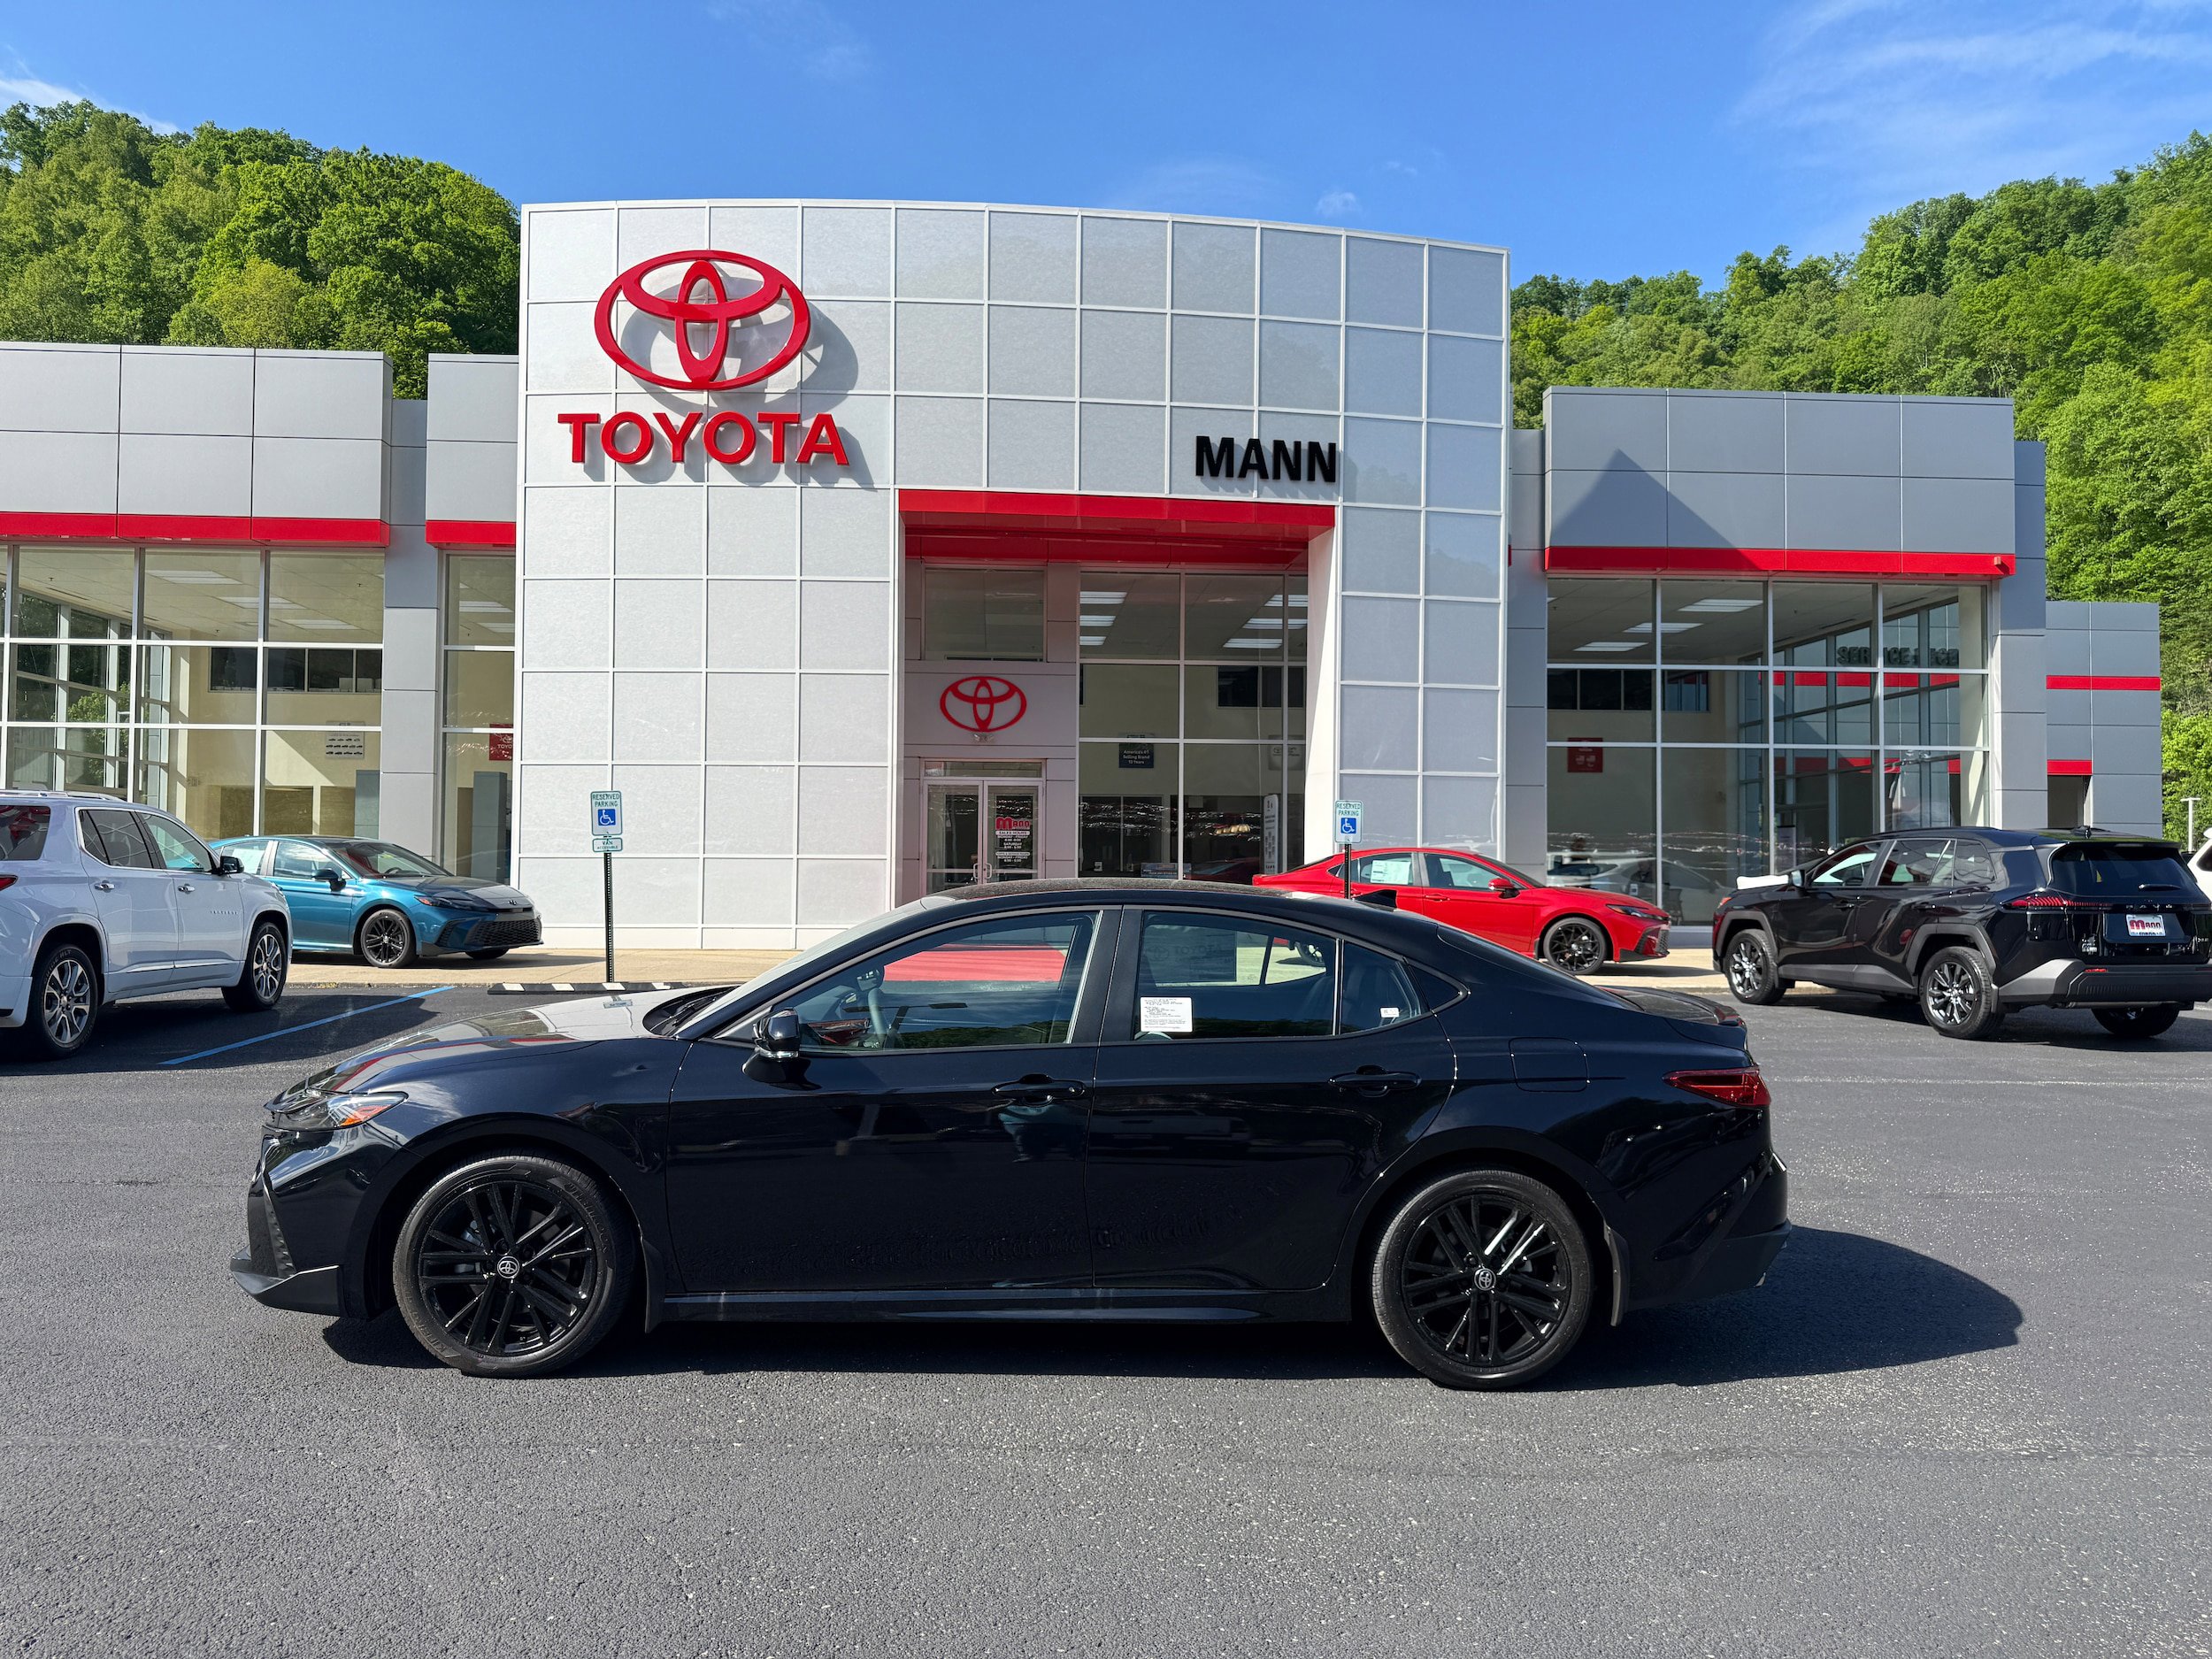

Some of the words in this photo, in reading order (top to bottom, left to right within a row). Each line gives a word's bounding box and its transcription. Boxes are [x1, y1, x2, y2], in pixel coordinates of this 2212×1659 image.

[557, 411, 850, 466] TOYOTA
[1195, 435, 1337, 483] MANN
[1837, 646, 1909, 665] SERICE
